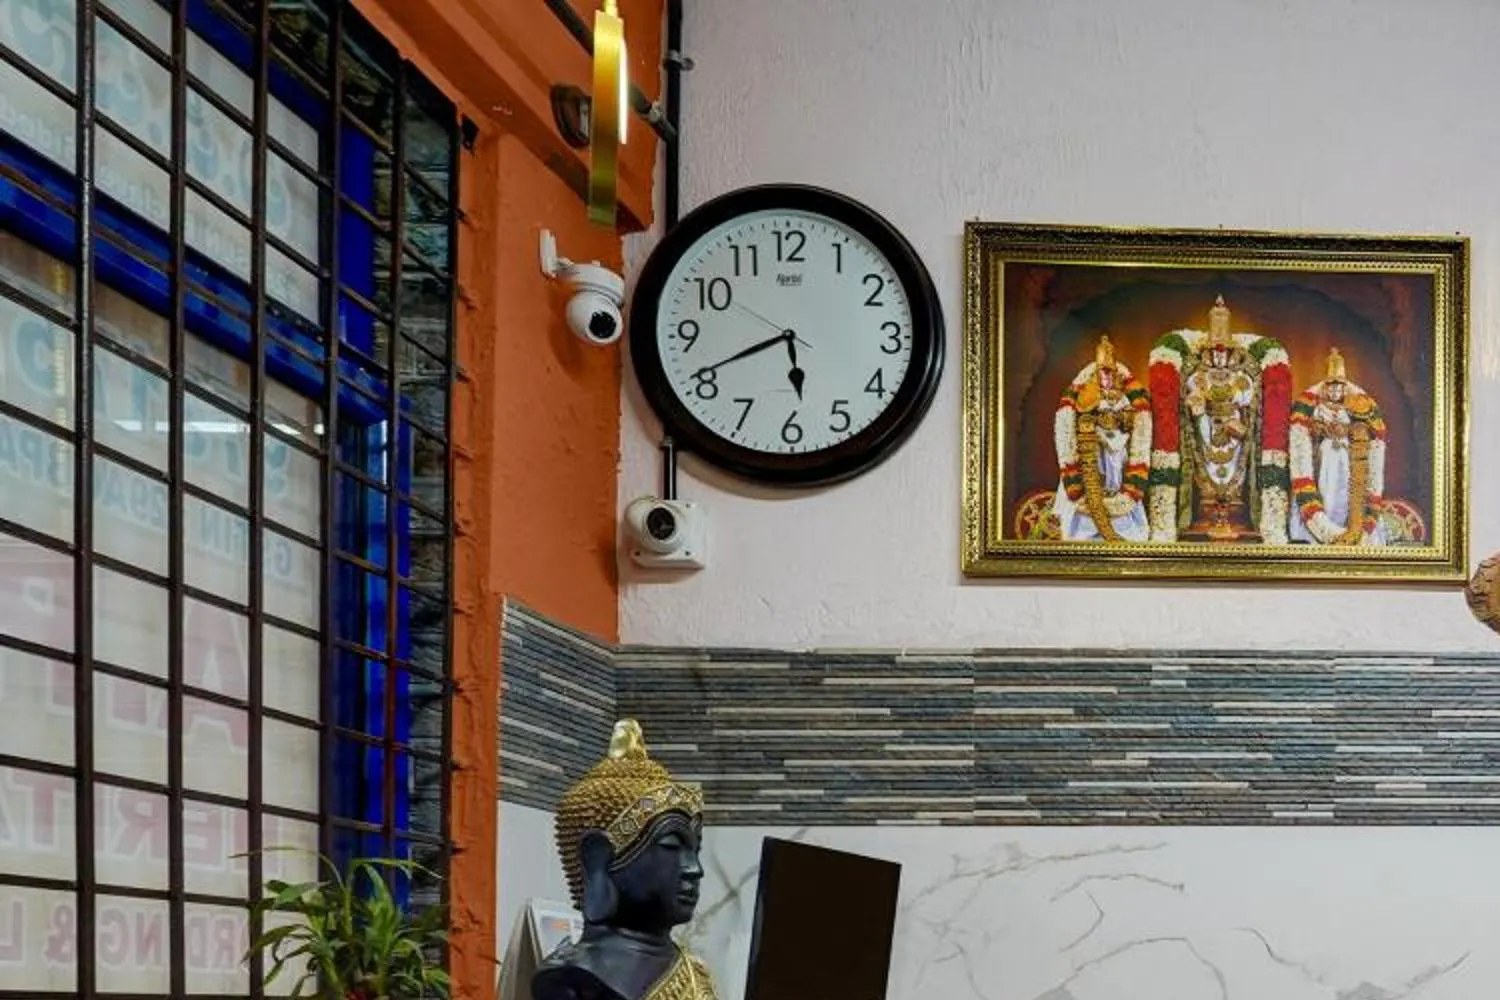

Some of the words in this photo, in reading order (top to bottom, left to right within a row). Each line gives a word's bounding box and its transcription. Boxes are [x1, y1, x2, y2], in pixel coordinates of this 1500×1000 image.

[729, 244, 759, 276] 11
[771, 231, 806, 263] 12
[831, 243, 842, 274] 1
[694, 277, 732, 311] 10
[862, 274, 884, 307] 2
[677, 319, 699, 352] 9
[880, 322, 902, 355] 3
[695, 367, 719, 400] 8
[863, 367, 887, 399] 4
[733, 398, 755, 432] 7
[781, 411, 803, 444] 6
[829, 400, 851, 433] 5
